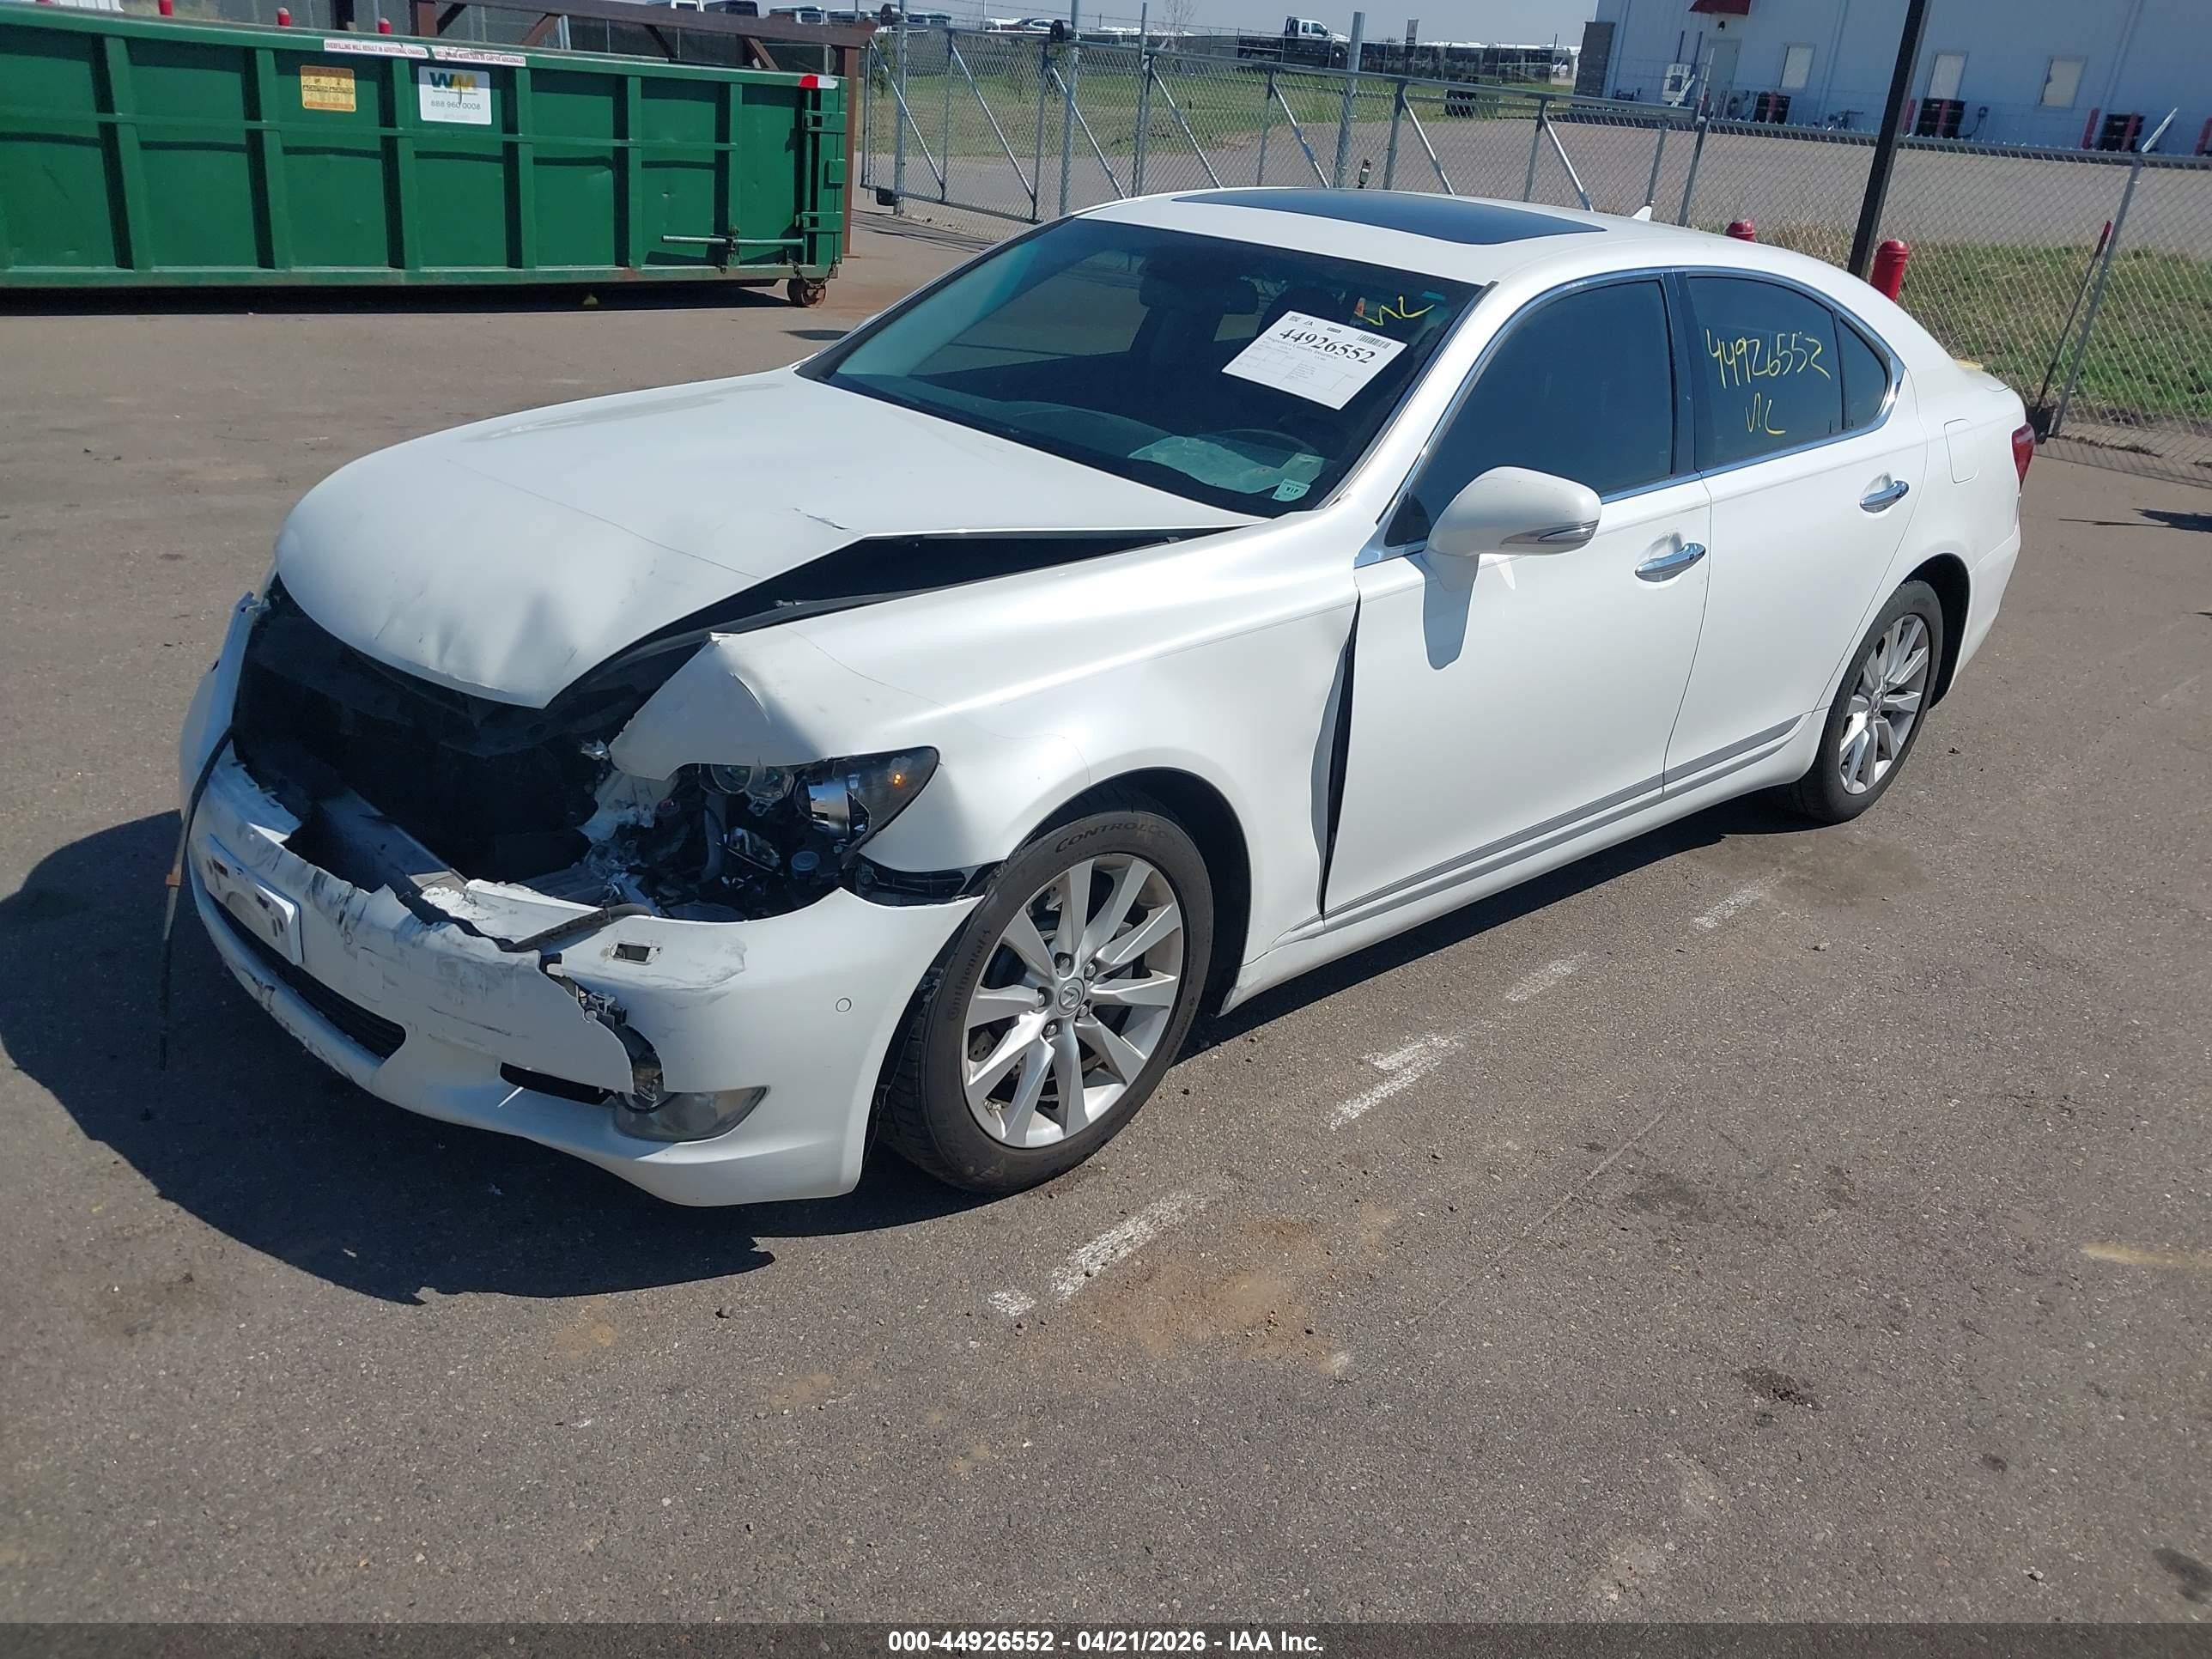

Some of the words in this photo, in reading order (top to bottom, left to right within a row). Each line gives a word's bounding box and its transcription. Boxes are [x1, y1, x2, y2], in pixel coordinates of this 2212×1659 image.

[429, 72, 477, 90] WM
[1279, 329, 1376, 364] 44926552
[1706, 329, 1831, 389] 44926552
